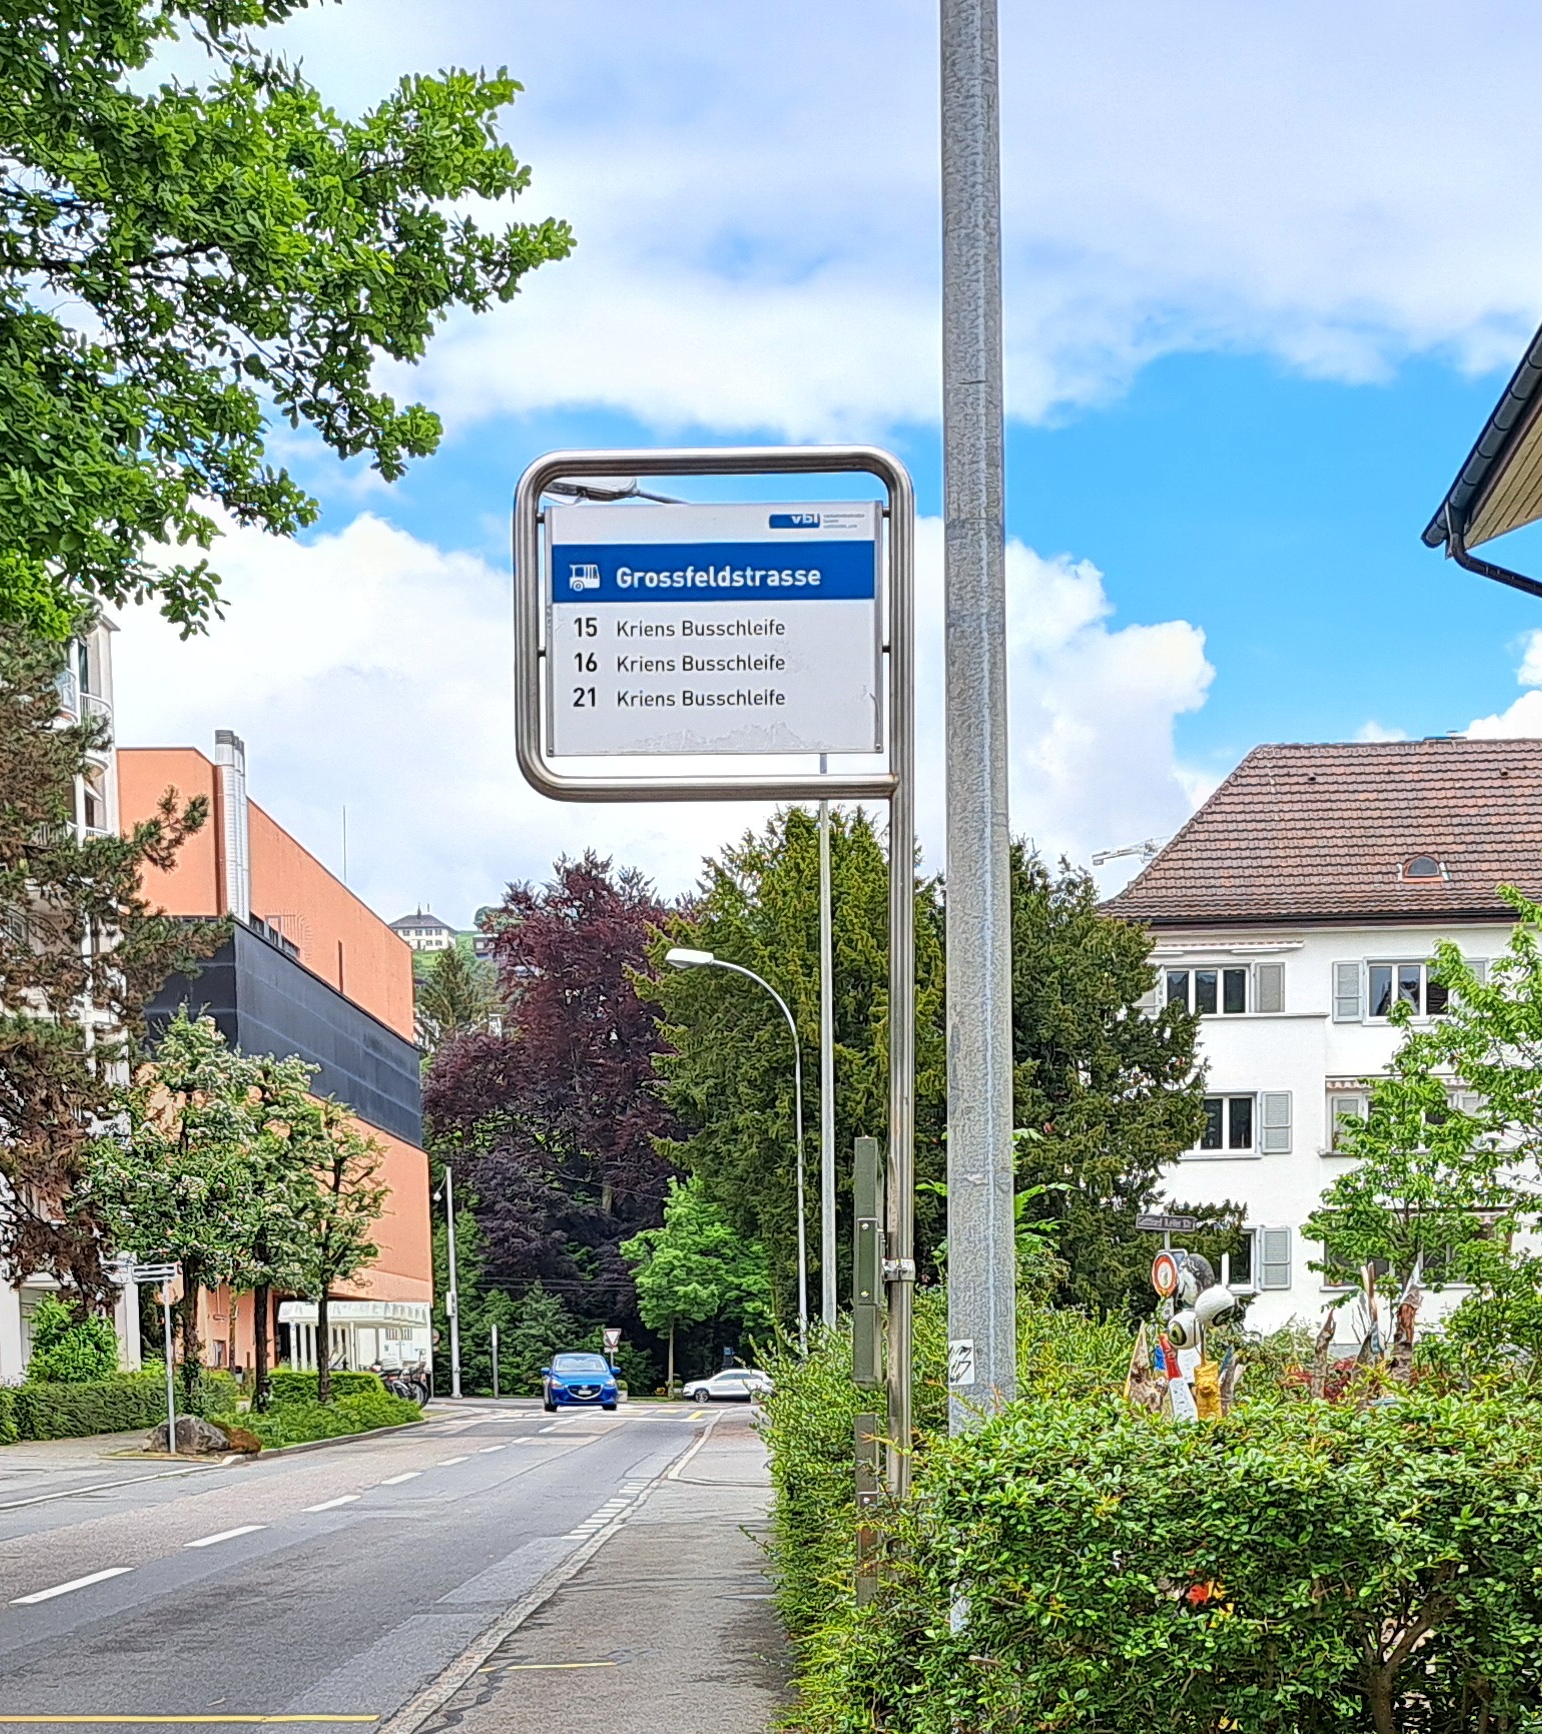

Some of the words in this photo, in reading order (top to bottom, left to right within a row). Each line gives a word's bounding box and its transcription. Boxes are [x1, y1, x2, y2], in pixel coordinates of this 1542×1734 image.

[791, 513, 819, 525] vbl
[616, 565, 821, 589] Grossfeldstrasse
[573, 617, 598, 638] 15
[616, 619, 676, 637] Kriens
[682, 619, 786, 637] Busschleife
[573, 652, 598, 673] 16
[616, 654, 676, 673] Kriens
[682, 654, 786, 672] Busschleife
[572, 687, 597, 708] 21
[616, 689, 676, 707] Kriens
[682, 689, 786, 707] Busschleife
